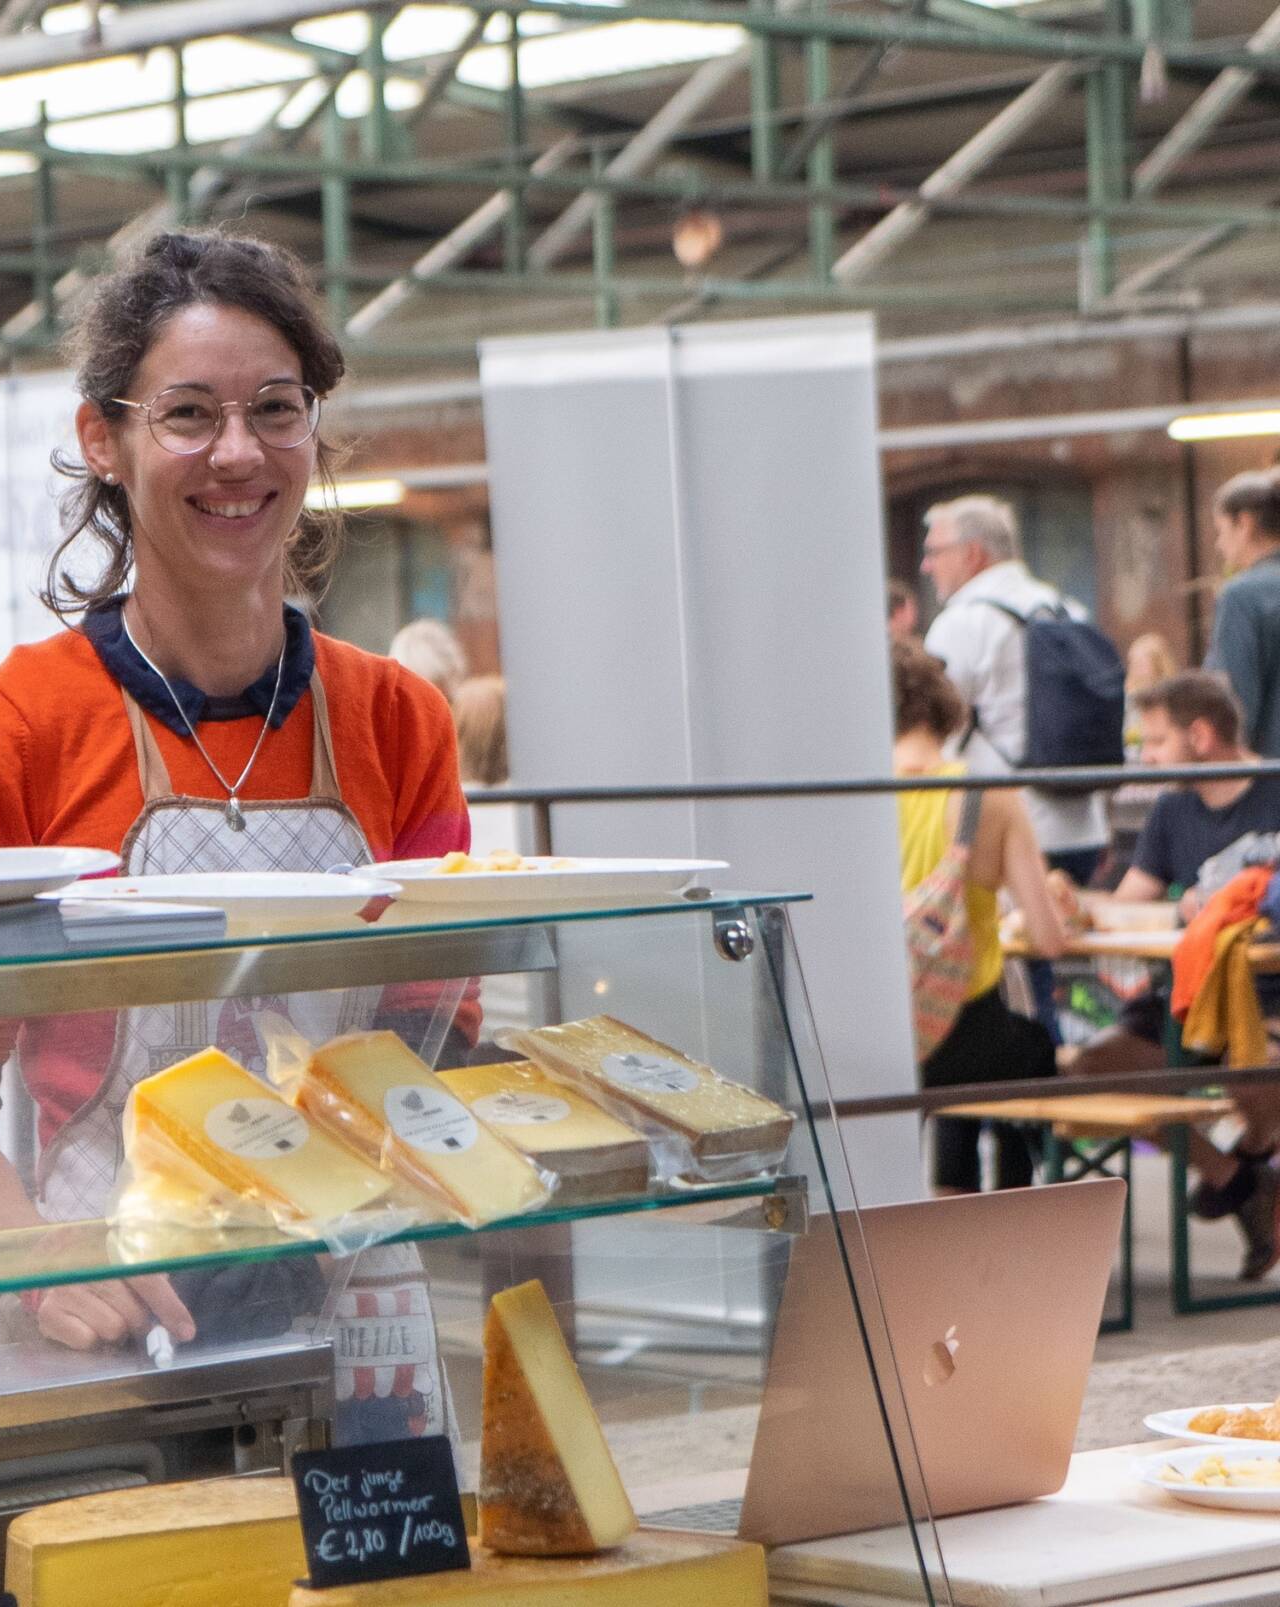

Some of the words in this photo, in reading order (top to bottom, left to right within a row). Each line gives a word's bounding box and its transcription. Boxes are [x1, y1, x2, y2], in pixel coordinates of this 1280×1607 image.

[305, 1468, 350, 1495] Der
[361, 1469, 404, 1497] junge
[319, 1493, 434, 1524] Pellwormer
